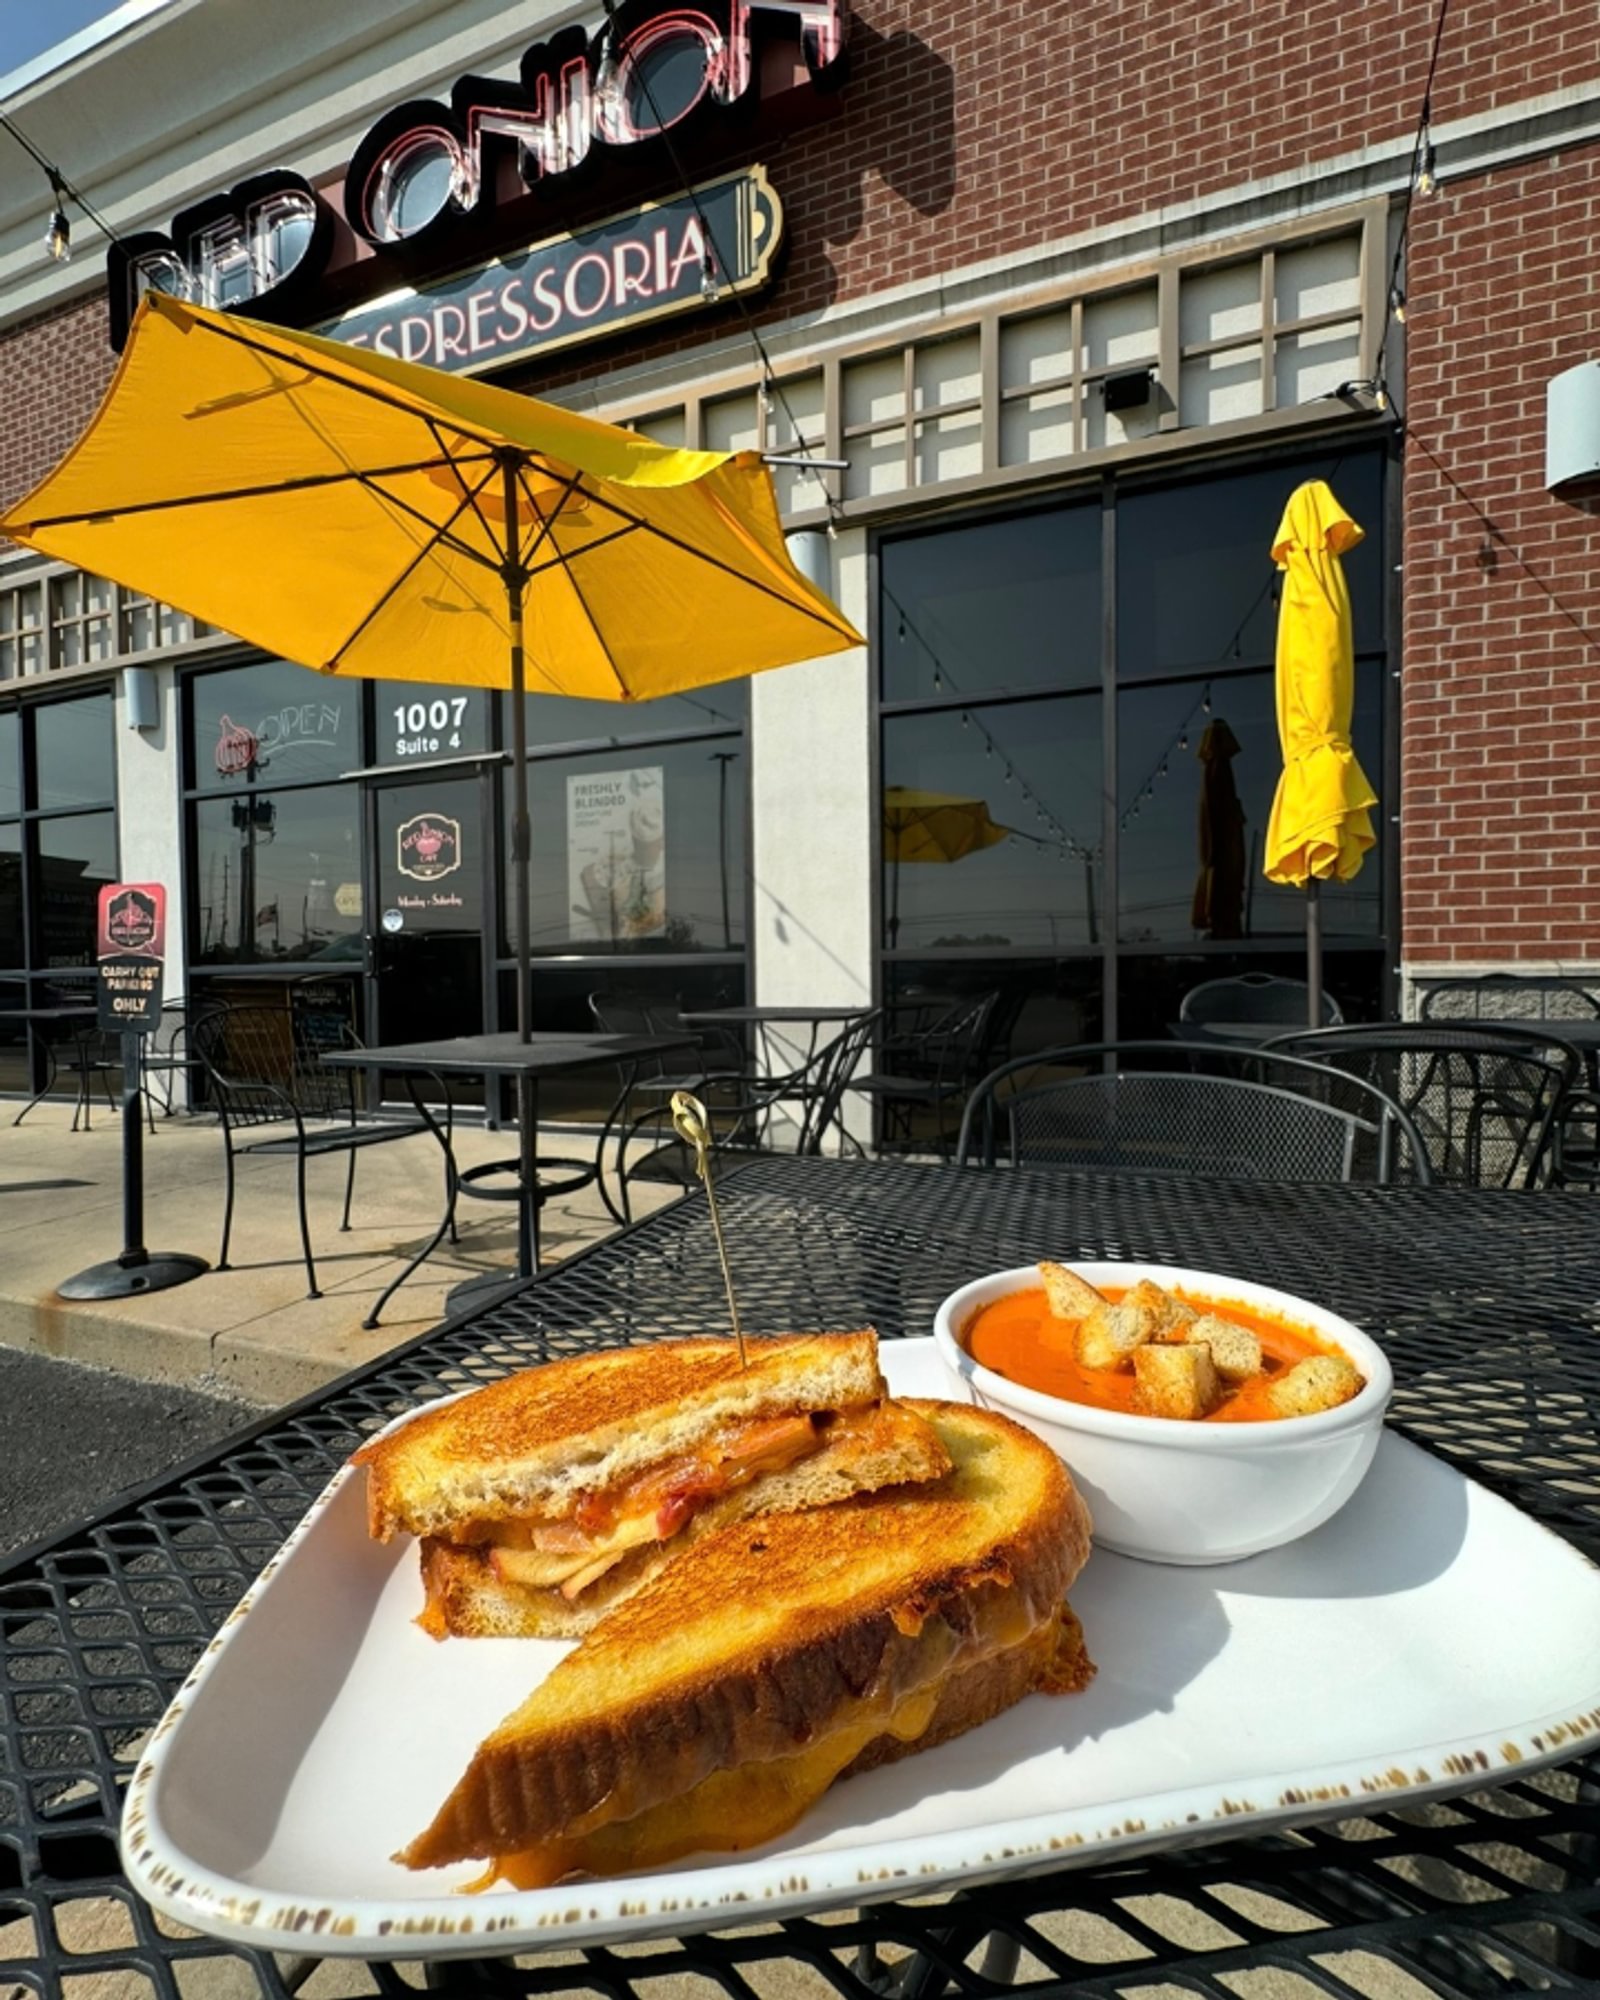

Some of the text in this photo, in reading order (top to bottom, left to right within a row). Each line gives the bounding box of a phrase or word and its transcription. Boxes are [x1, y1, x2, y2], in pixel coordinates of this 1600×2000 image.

[352, 0, 845, 245] ONION
[256, 704, 341, 746] OPEN
[394, 698, 467, 735] 1007
[395, 732, 461, 756] Suite 4
[575, 782, 622, 796] FRESHLY
[575, 795, 626, 809] BLENDED
[113, 998, 147, 1012] ONLY
